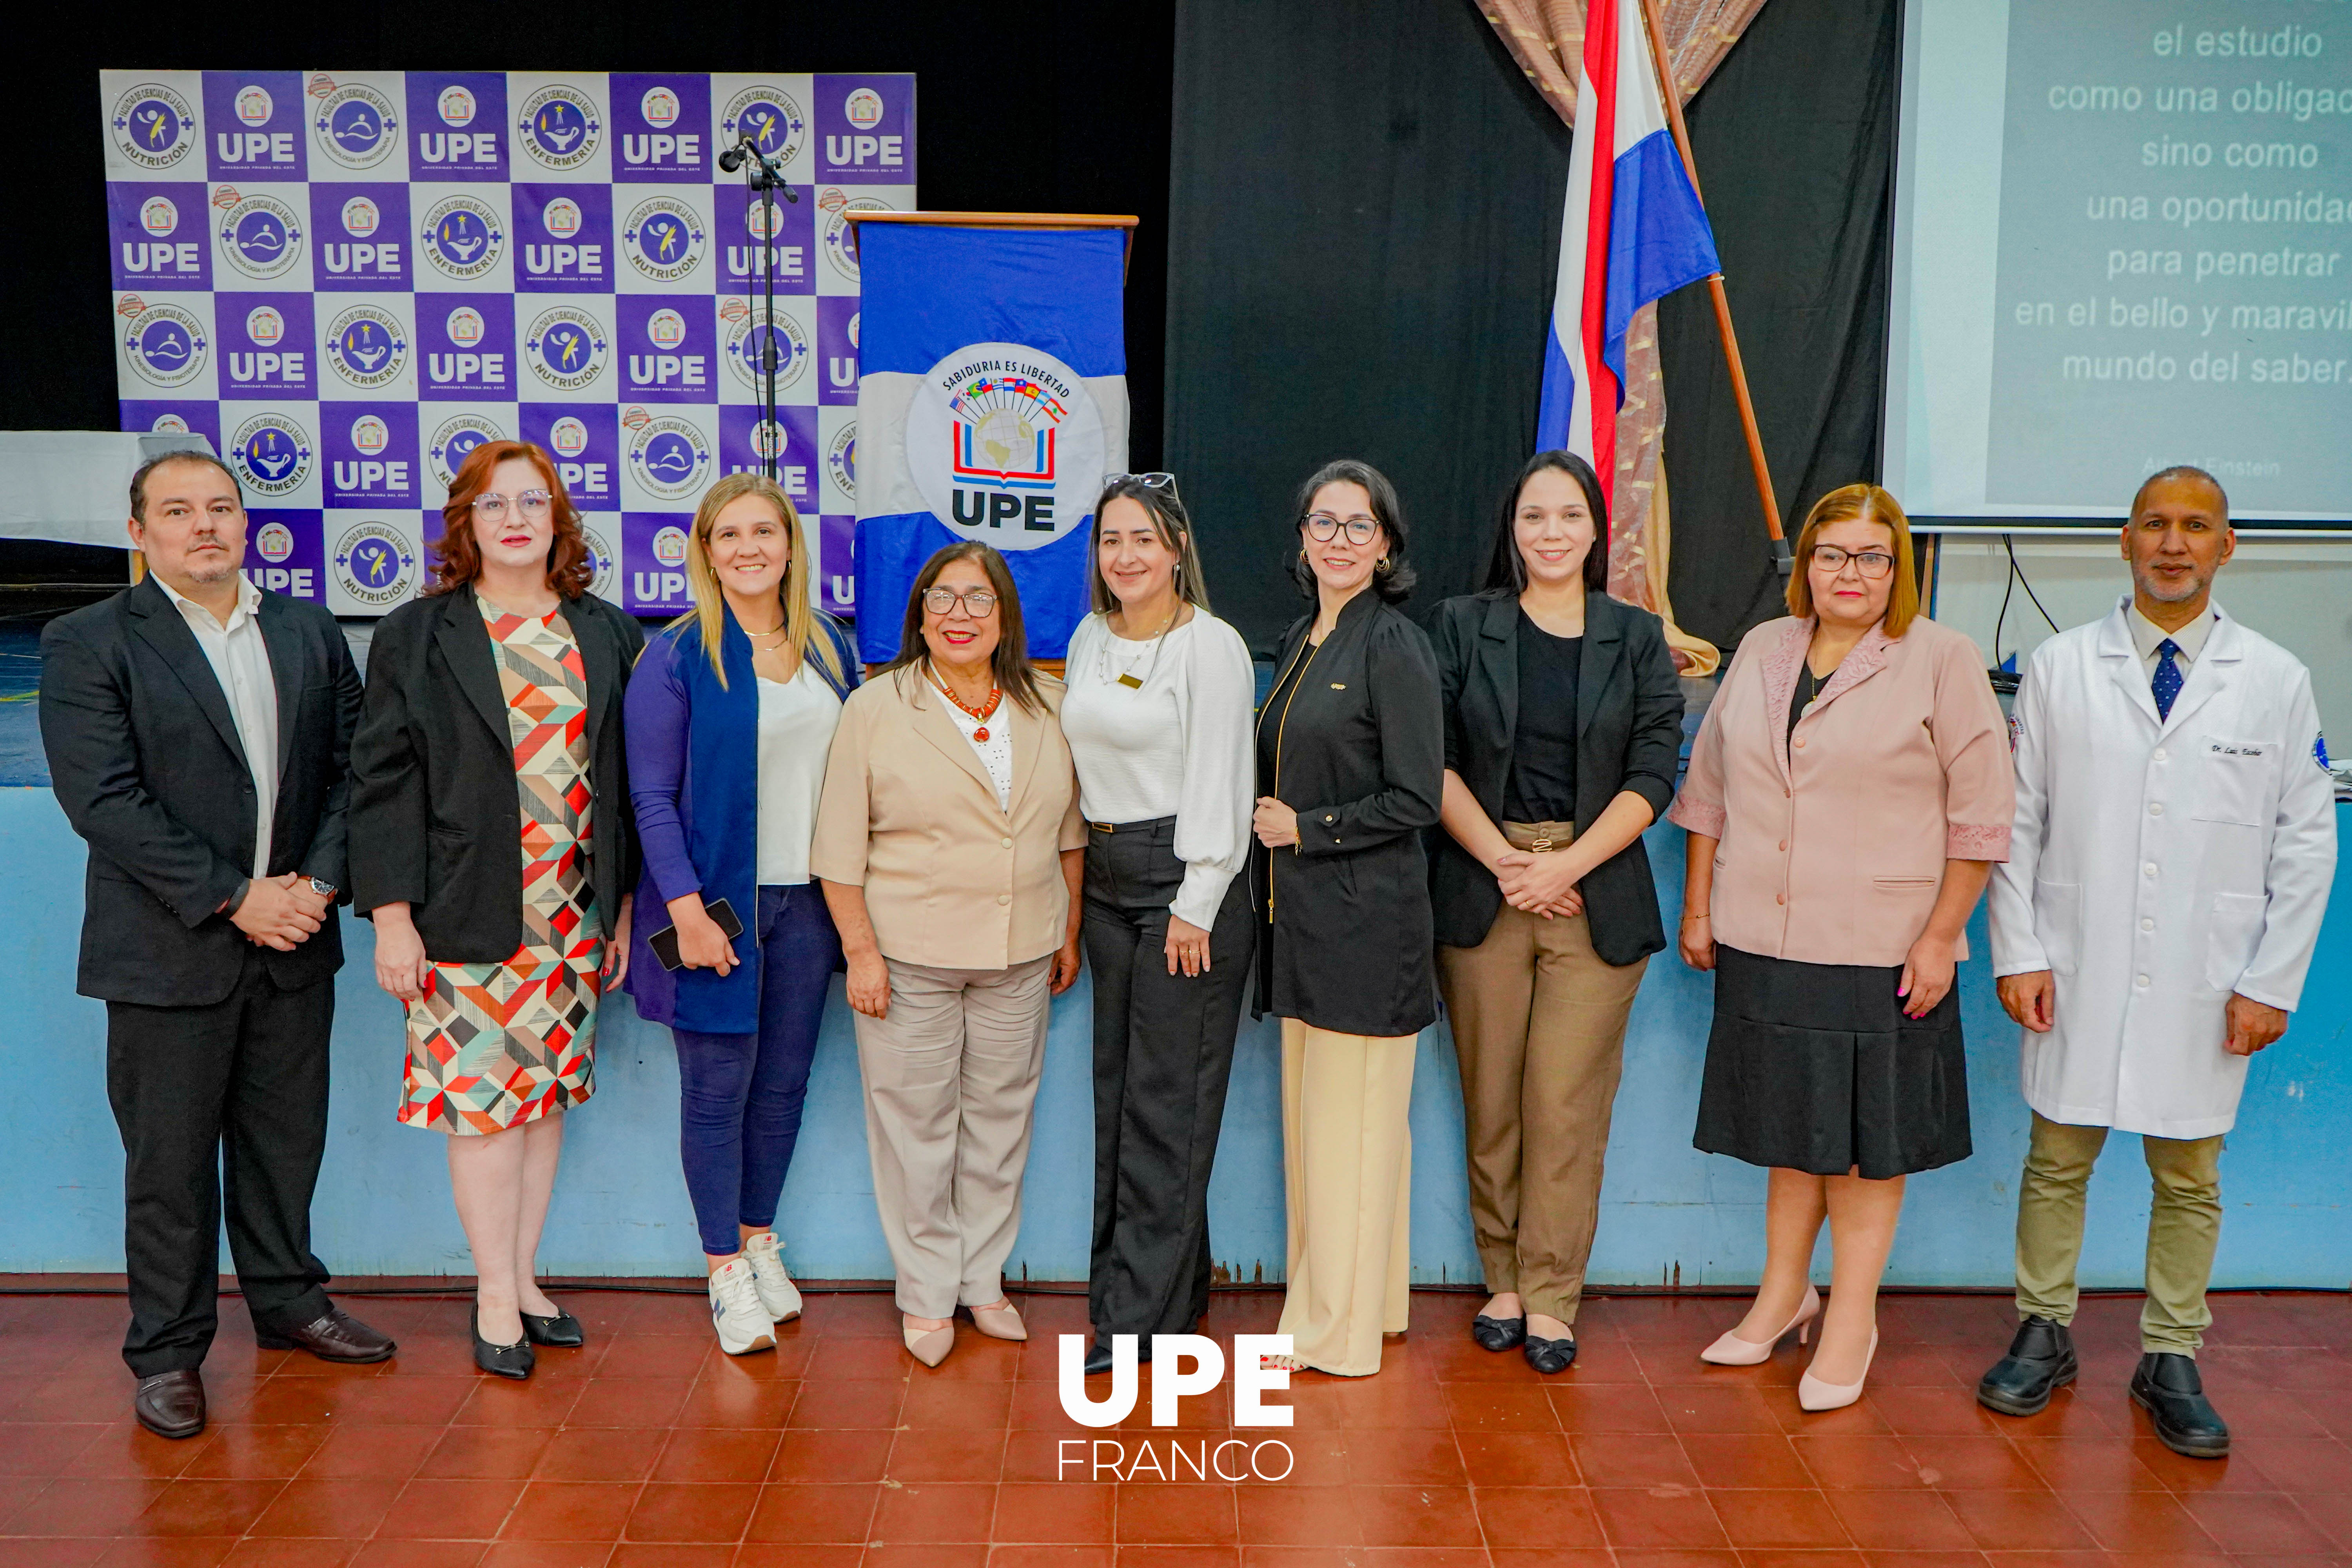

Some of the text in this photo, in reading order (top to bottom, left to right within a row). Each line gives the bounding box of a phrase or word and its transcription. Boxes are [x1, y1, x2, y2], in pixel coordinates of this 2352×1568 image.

[2153, 24, 2322, 58] el estudio
[119, 88, 188, 117] FACULTAD DE CIENCIAS DE LA SALUD
[321, 89, 390, 117] FACULTAD DE CIENCIAS DE LA SALUD
[525, 89, 594, 118] FACULTAD DE CIENCIAS DE LA SALUD
[728, 91, 797, 119] FACULTAD DE CIENCIAS DE LA SALUD
[2048, 85, 2141, 110] como
[2156, 87, 2218, 112] una
[122, 142, 187, 166] NUTRICIÓN
[218, 133, 294, 162] UPE
[420, 133, 497, 162] UPE
[526, 138, 595, 165] ENFERMERÍA
[623, 134, 700, 163] UPE
[827, 136, 902, 165] UPE
[2142, 134, 2319, 169] sino como
[226, 200, 295, 228] FACULTAD DE CIENCIAS DE LA SALUD
[428, 200, 496, 228] FACULTAD DE CIENCIAS DE LA SALUD
[630, 201, 699, 229] FACULTAD DE CIENCIAS DE LA SALUD
[2087, 196, 2148, 220] una
[123, 243, 200, 272] UPE
[325, 244, 400, 272] UPE
[429, 248, 497, 275] ENFERMERÍA
[526, 245, 602, 274] UPE
[632, 254, 697, 278] NUTRICIÓN
[2108, 247, 2341, 282] para penetrar
[131, 309, 200, 337] FACULTAD DE CIENCIAS DE LA SALUD
[332, 310, 400, 338] FACULTAD DE CIENCIAS DE LA SALUD
[532, 311, 601, 339] FACULTAD DE CIENCIAS DE LA SALUD
[2016, 302, 2054, 325] en
[2068, 297, 2096, 326] el
[2111, 297, 2188, 328] bello
[2201, 305, 2219, 336] y
[230, 353, 305, 381] UPE
[334, 357, 401, 384] ENFERMERÍA
[429, 354, 505, 382] UPE
[535, 363, 599, 387] NUTRICIÓN
[630, 355, 705, 384] UPE
[943, 360, 1069, 398] SABIDURIA ES LIBERTAD
[2063, 351, 2176, 381] mundo
[2189, 351, 2238, 381] del
[237, 417, 305, 446] FACULTAD DE CIENCIAS DE LA SALUD
[436, 419, 493, 447] FACULTAD DE CIENCIAS DE LA
[635, 421, 704, 449] FACULTAD DE CIENCIAS DE LA SALUD
[239, 465, 306, 492] ENFERMERÍA
[334, 461, 408, 490] UPE
[554, 463, 608, 492] PE
[952, 489, 1054, 531] UPE
[341, 526, 408, 554] FACULTAD DE CIENCIAS DE LA SALUD
[343, 578, 407, 601] NUTRICIÓN
